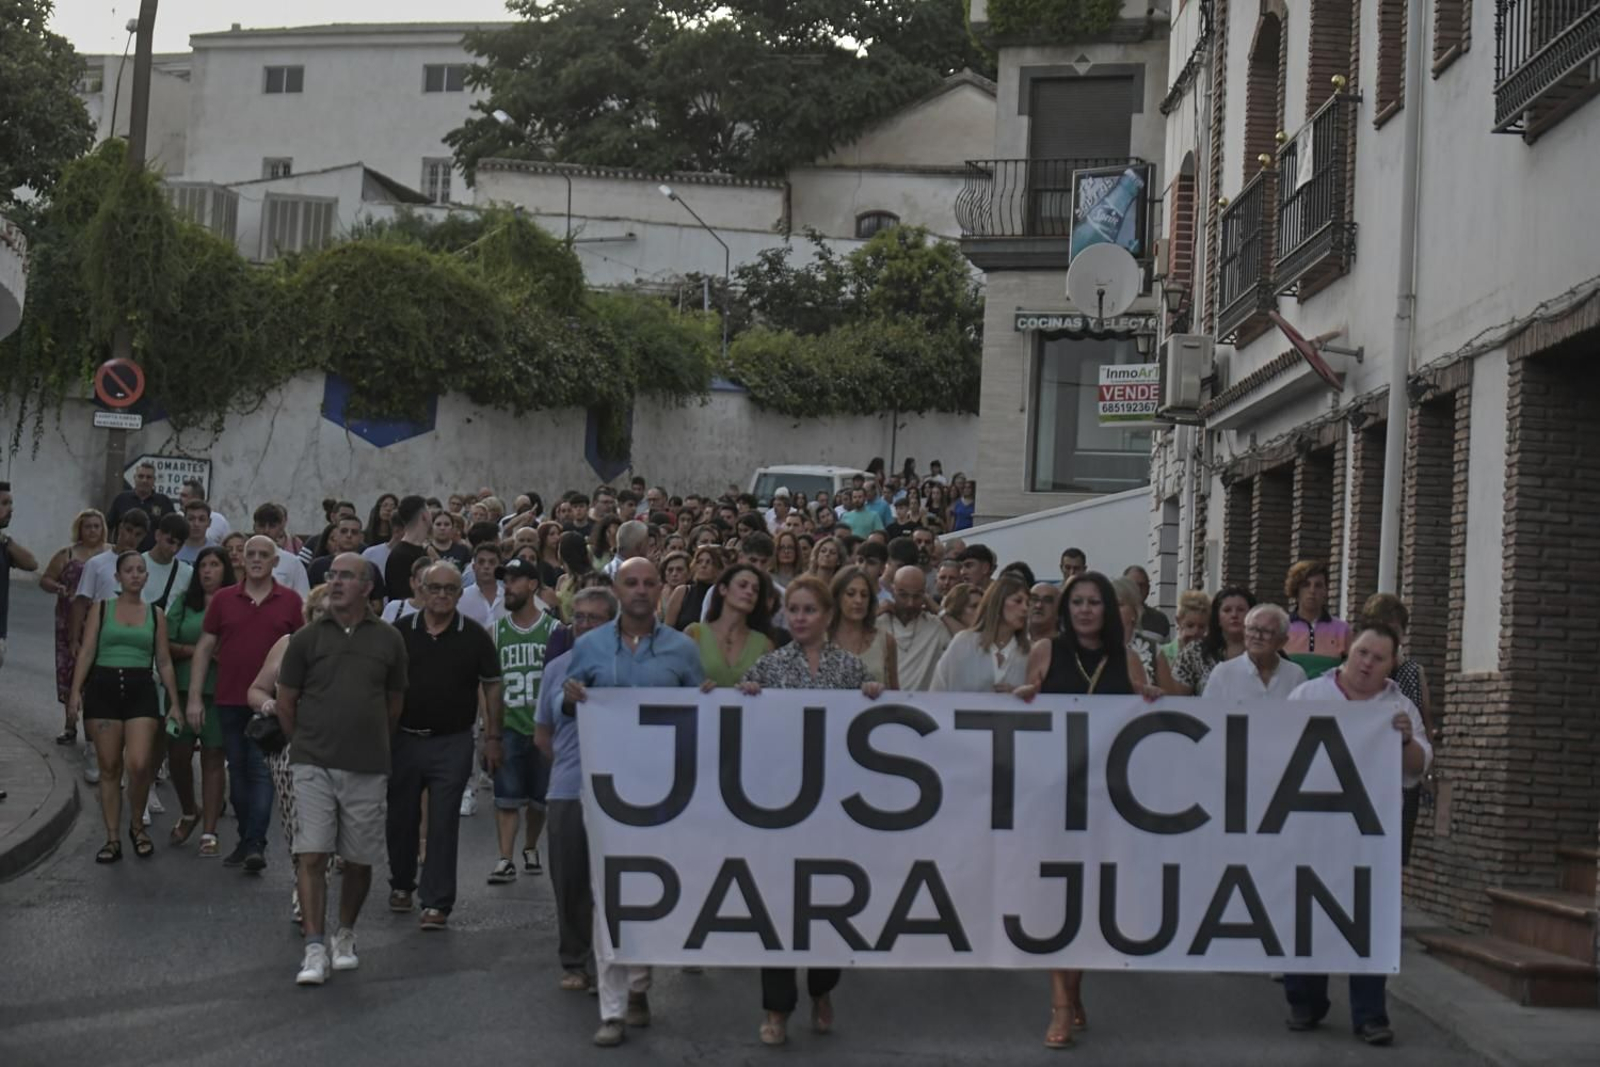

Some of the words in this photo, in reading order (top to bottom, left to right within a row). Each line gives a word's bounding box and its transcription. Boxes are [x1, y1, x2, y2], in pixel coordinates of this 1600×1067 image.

[1017, 317, 1082, 329] COCINAS
[1087, 318, 1096, 328] Y
[1102, 385, 1159, 400] VENDE
[501, 643, 547, 669] CELTICS
[504, 671, 543, 708] 20
[591, 704, 1386, 836] JUSTICIA
[604, 855, 973, 951] PARA
[1003, 861, 1371, 958] JUAN
